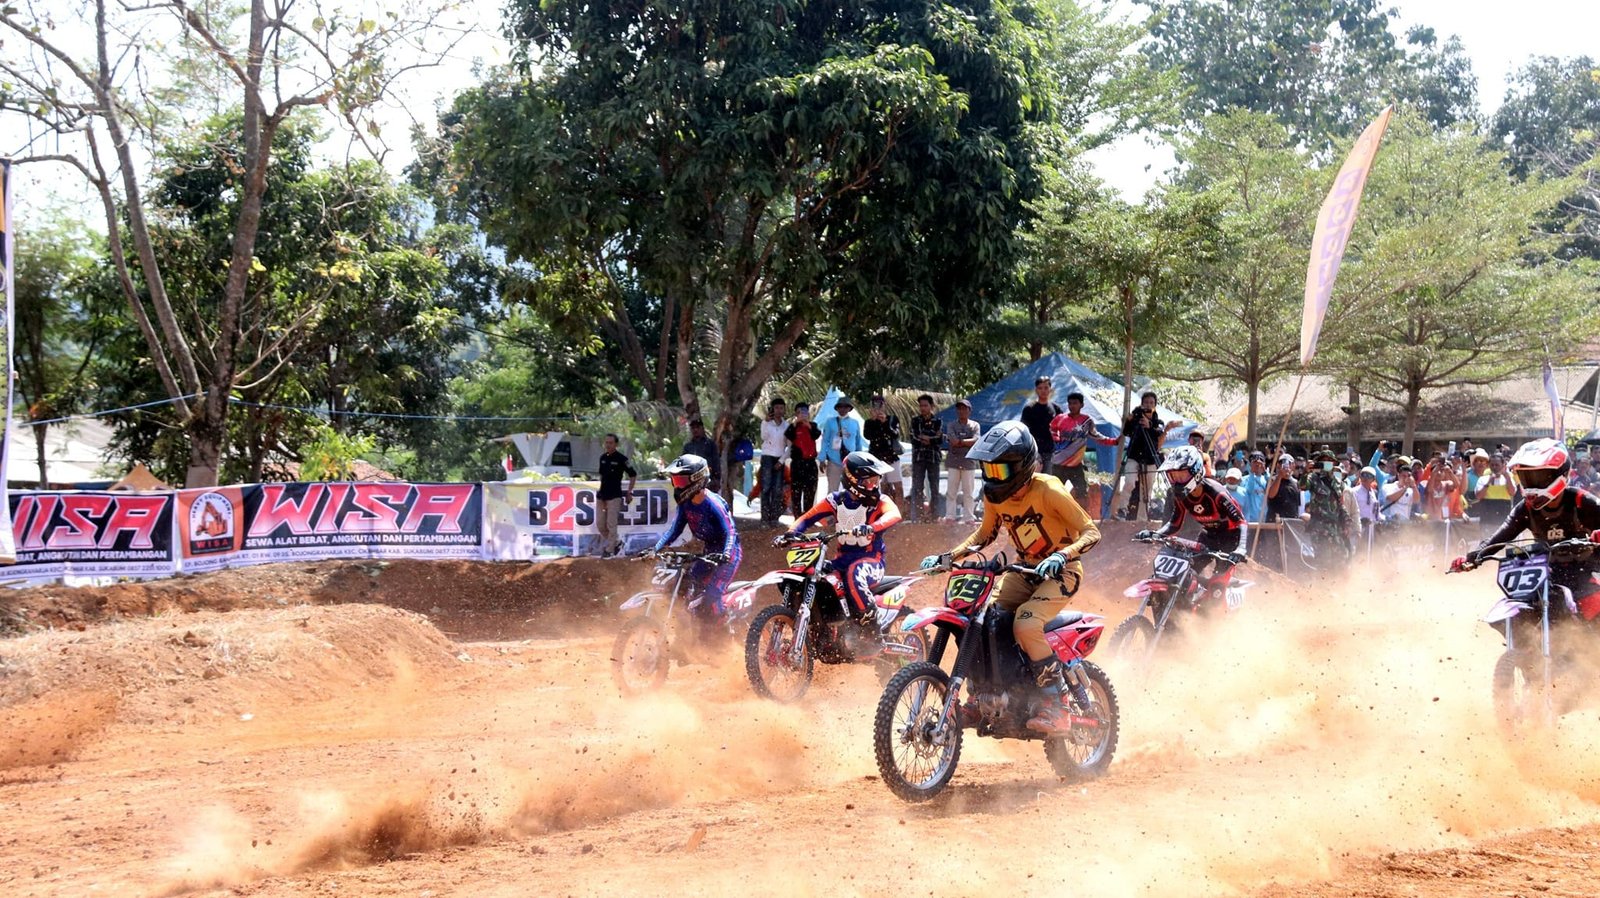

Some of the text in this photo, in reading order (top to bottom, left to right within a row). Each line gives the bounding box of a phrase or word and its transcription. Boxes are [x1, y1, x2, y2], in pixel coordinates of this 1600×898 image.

[248, 484, 474, 537] WISA
[245, 537, 273, 547] SEWA
[275, 536, 297, 545] ALAT
[299, 535, 330, 544] BERAT,
[331, 533, 380, 543] ANGKUTAN
[403, 534, 477, 543] PERTAMBANGAN
[1547, 529, 1565, 540] 03
[195, 538, 229, 549] WISA
[81, 551, 98, 559] DAN
[100, 551, 167, 559] PERTAMBANGAN
[791, 549, 816, 563] 22
[1155, 556, 1186, 578] 201
[651, 568, 678, 585] 27
[1503, 569, 1543, 592] 03
